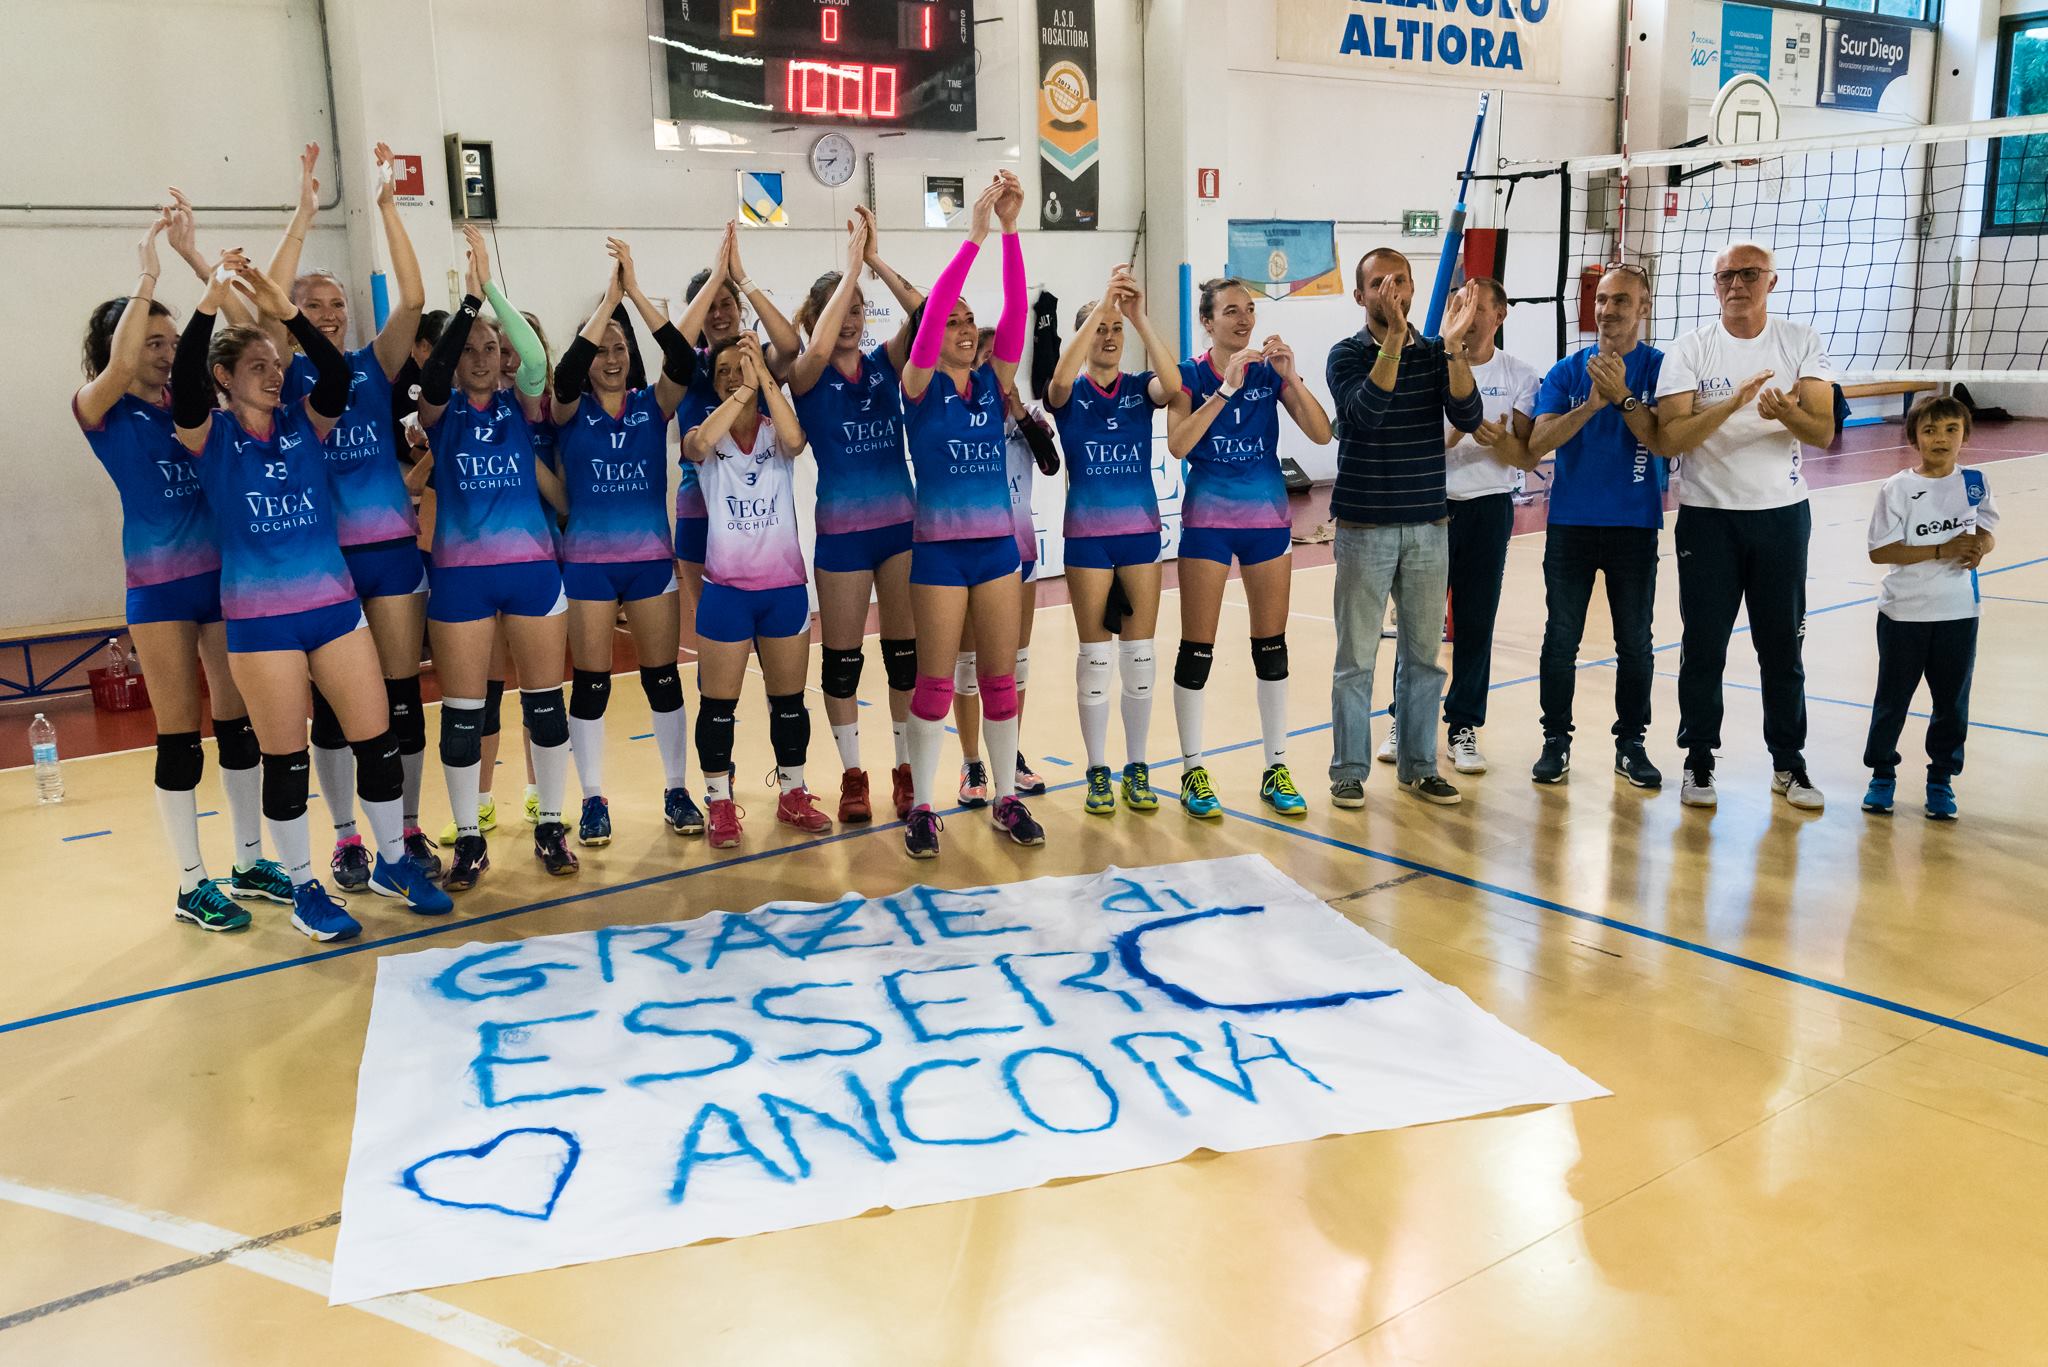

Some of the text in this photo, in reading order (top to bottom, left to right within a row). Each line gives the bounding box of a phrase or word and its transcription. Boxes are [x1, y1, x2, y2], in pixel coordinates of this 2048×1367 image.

[732, 0, 757, 36] 2
[822, 8, 838, 42] 0
[923, 6, 931, 49] 1
[1053, 9, 1077, 28] A.S.D.
[1042, 27, 1089, 48] ROSALTIORA
[1339, 13, 1524, 71] ALTIORA
[1840, 34, 1904, 66] Scur Diego
[691, 62, 708, 72] TIME
[947, 79, 962, 88] TIME
[1837, 84, 1873, 97] MERGOZZO
[949, 103, 963, 112] OUT
[859, 398, 871, 411] 2
[969, 411, 988, 427] 10
[1106, 417, 1119, 431] 5
[1233, 407, 1241, 425] 1
[473, 426, 494, 443] 12
[842, 418, 895, 442] VEGA
[609, 431, 627, 449] 17
[1210, 435, 1265, 455] VEGA
[947, 439, 1001, 461] VEGA
[1083, 440, 1141, 463] VEGA
[264, 461, 289, 481] 23
[455, 452, 520, 476] VEGA
[591, 458, 647, 481] VEGA
[1086, 465, 1143, 476] OCCHIALI
[459, 477, 522, 490] OCCHIALI
[592, 481, 649, 493] OCCHIALI
[745, 471, 758, 486] 3
[245, 490, 316, 518] VEGA
[725, 495, 778, 519] VEGA
[250, 517, 318, 533] OCCHIALI
[727, 519, 780, 531] OCCHIALI
[433, 884, 1034, 1000] GRAZIE
[670, 1021, 1335, 1206] ANCORA
